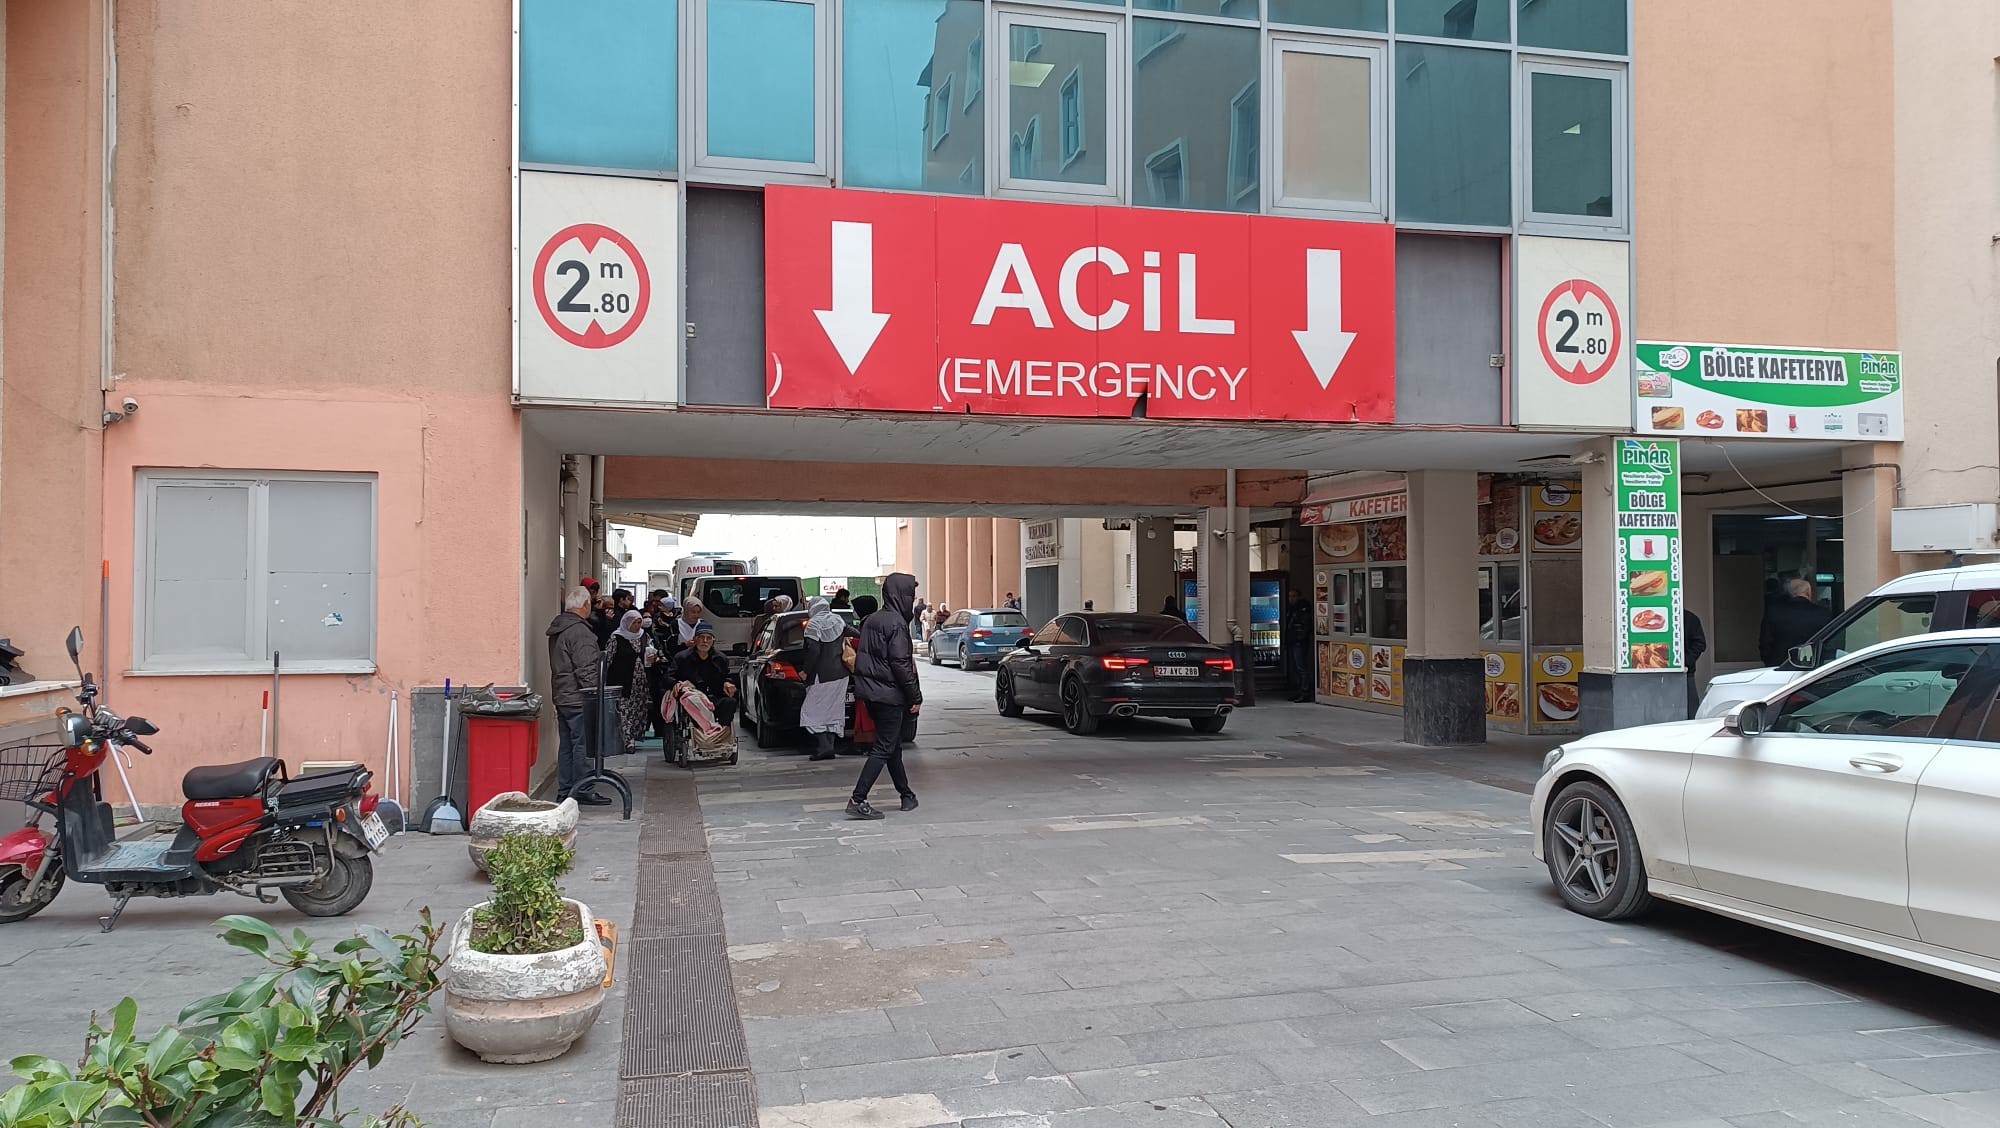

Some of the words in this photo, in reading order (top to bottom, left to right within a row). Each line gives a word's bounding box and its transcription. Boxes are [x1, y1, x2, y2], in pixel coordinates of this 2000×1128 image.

[556, 260, 591, 313] 2
[600, 262, 623, 279] m
[1555, 309, 1580, 354] 2
[1586, 312, 1603, 326] m
[1703, 351, 1755, 379] BÖLGE
[1758, 357, 1845, 382] KAFETERYA
[1861, 360, 1896, 374] PINAR
[1623, 449, 1670, 464] PINAR
[1630, 491, 1665, 508] BÖLGE
[1619, 513, 1677, 527] KAFETERYA
[686, 565, 713, 574] AMBU
